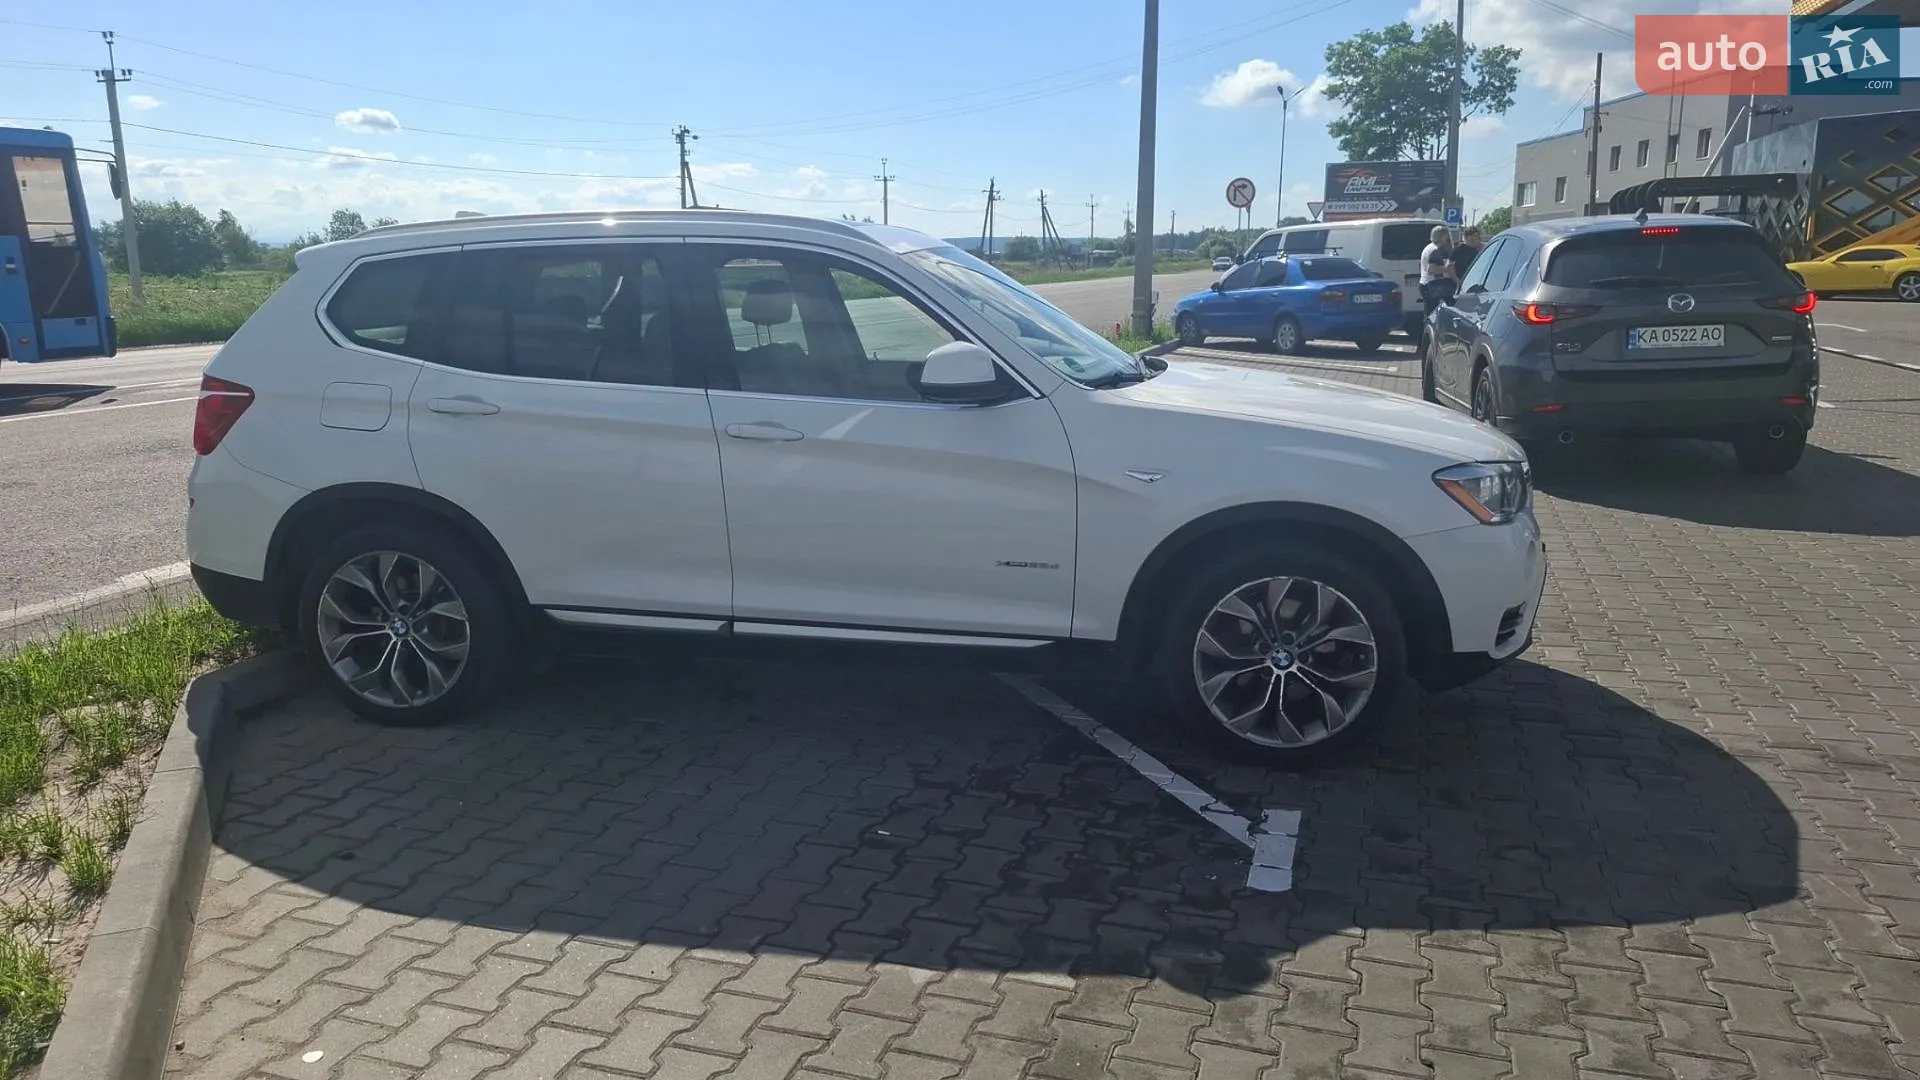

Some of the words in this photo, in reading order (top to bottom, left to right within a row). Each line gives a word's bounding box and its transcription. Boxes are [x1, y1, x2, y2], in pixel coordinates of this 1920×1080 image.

[1447, 208, 1457, 221] P
[1637, 329, 1659, 344] KA
[1662, 328, 1697, 342] 0522
[1700, 327, 1722, 341] AO
